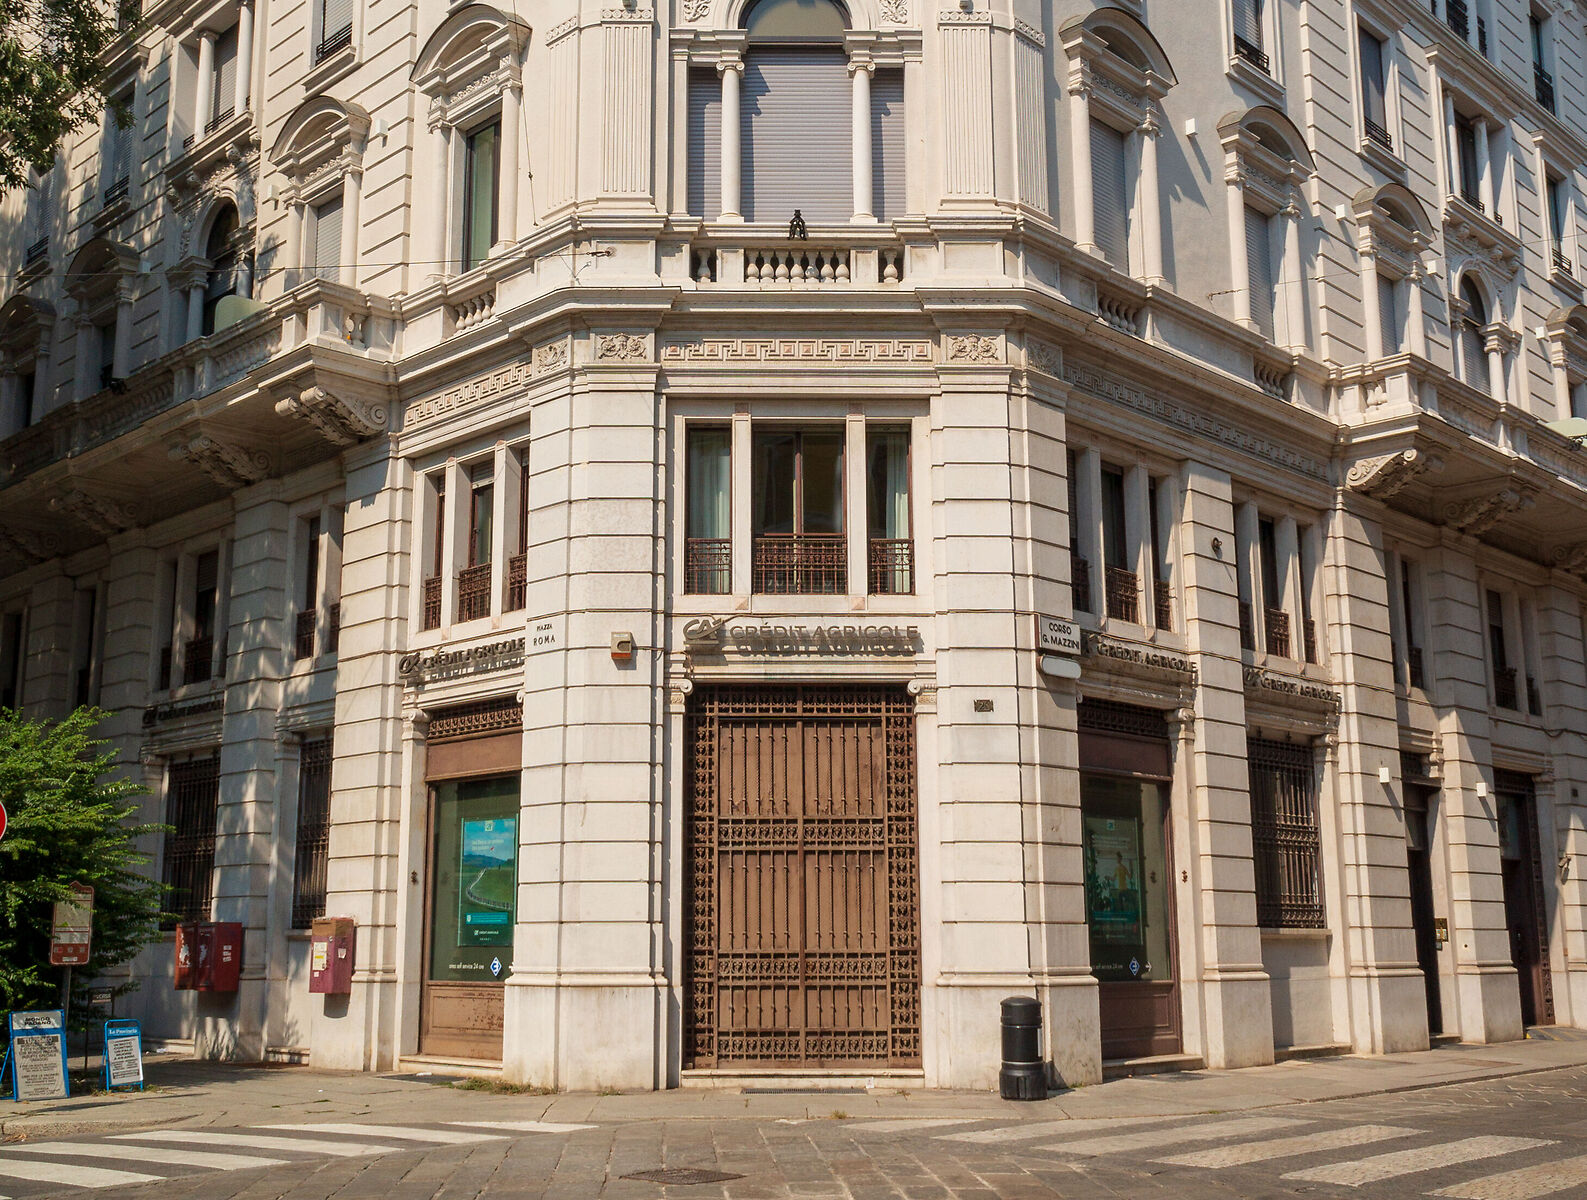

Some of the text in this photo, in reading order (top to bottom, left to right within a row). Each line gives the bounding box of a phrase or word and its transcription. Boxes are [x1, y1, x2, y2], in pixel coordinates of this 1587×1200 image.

[730, 621, 807, 639] CRÉDIT
[813, 625, 919, 640] AGRICOLE
[1048, 622, 1072, 635] CORSO
[533, 634, 556, 646] ROMA
[1042, 634, 1050, 644] G.
[1051, 636, 1080, 650] MAZZINI
[465, 637, 526, 661] AGRICOLE
[1144, 653, 1198, 673] AGRICOLE
